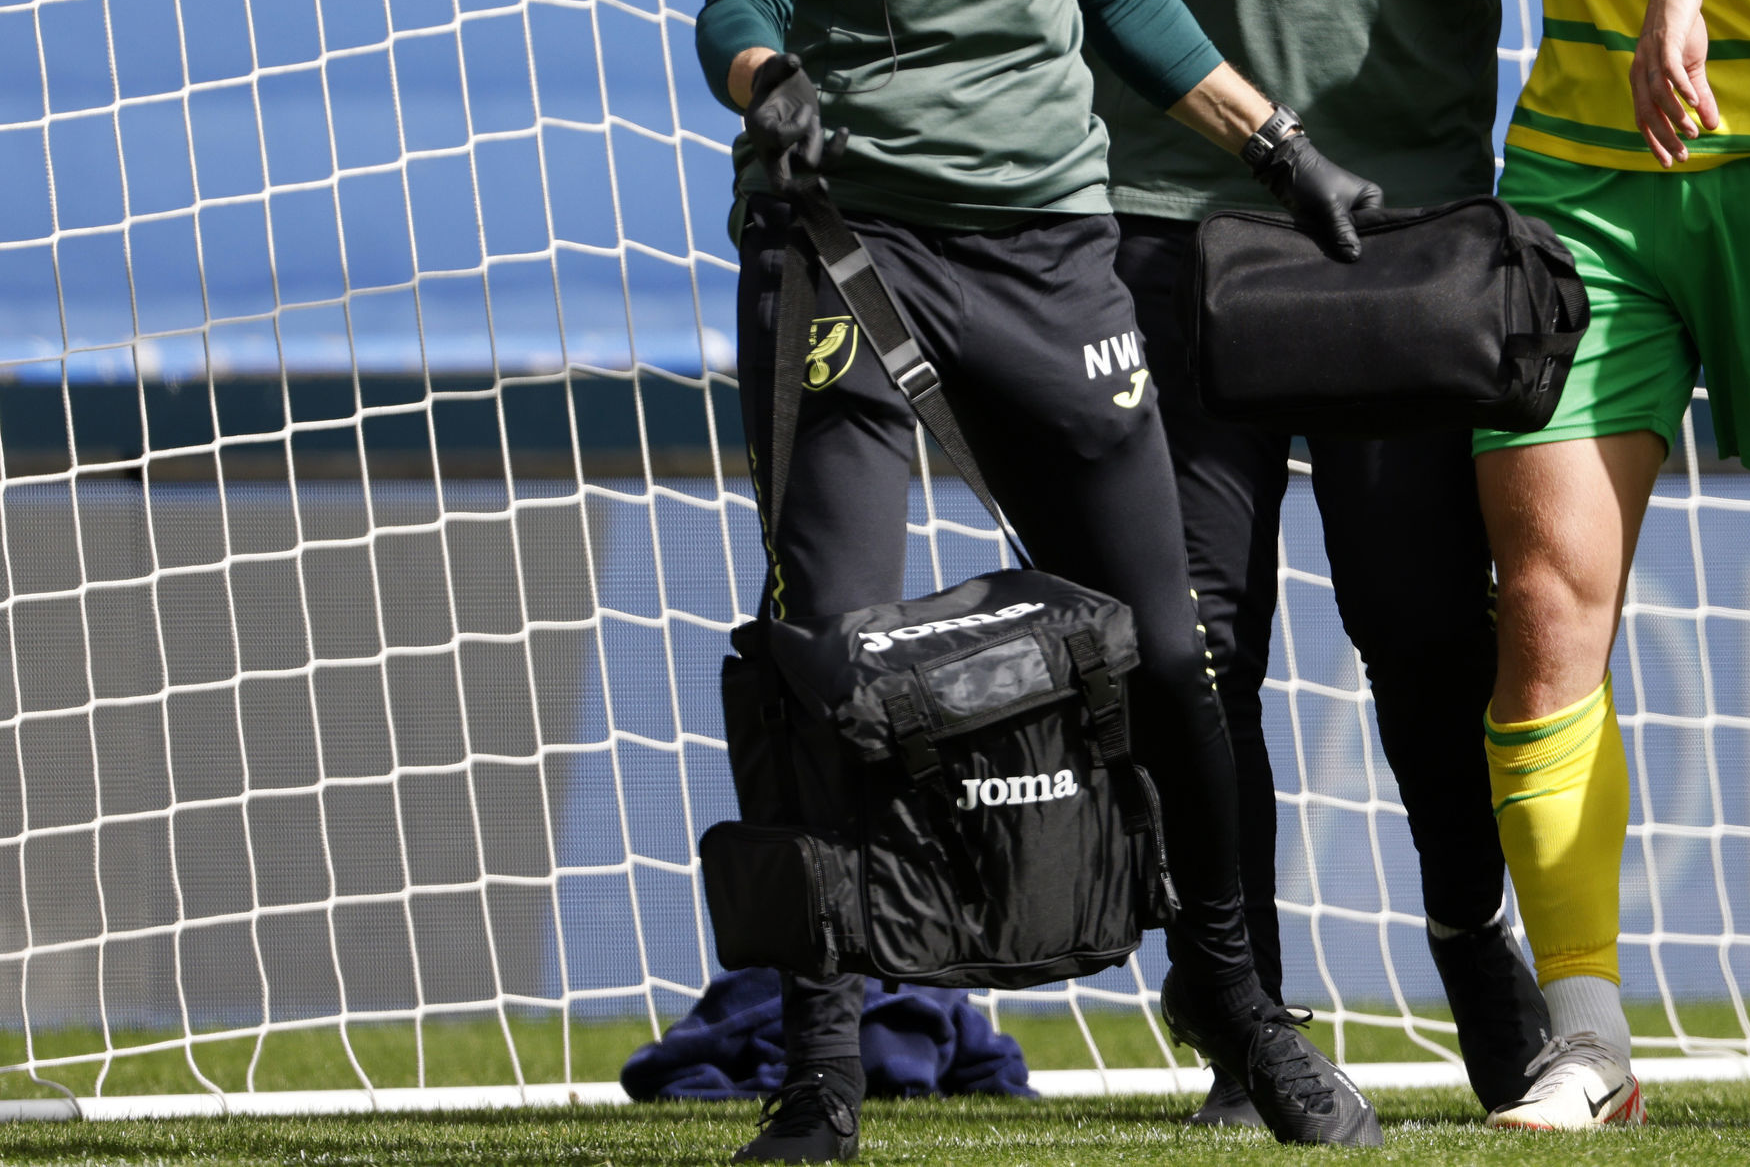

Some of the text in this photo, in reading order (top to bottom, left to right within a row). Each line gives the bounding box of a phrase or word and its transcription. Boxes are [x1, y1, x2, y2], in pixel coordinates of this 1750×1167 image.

[1083, 331, 1141, 380] NW
[857, 602, 1046, 653] Joma
[956, 769, 1079, 811] Joma
